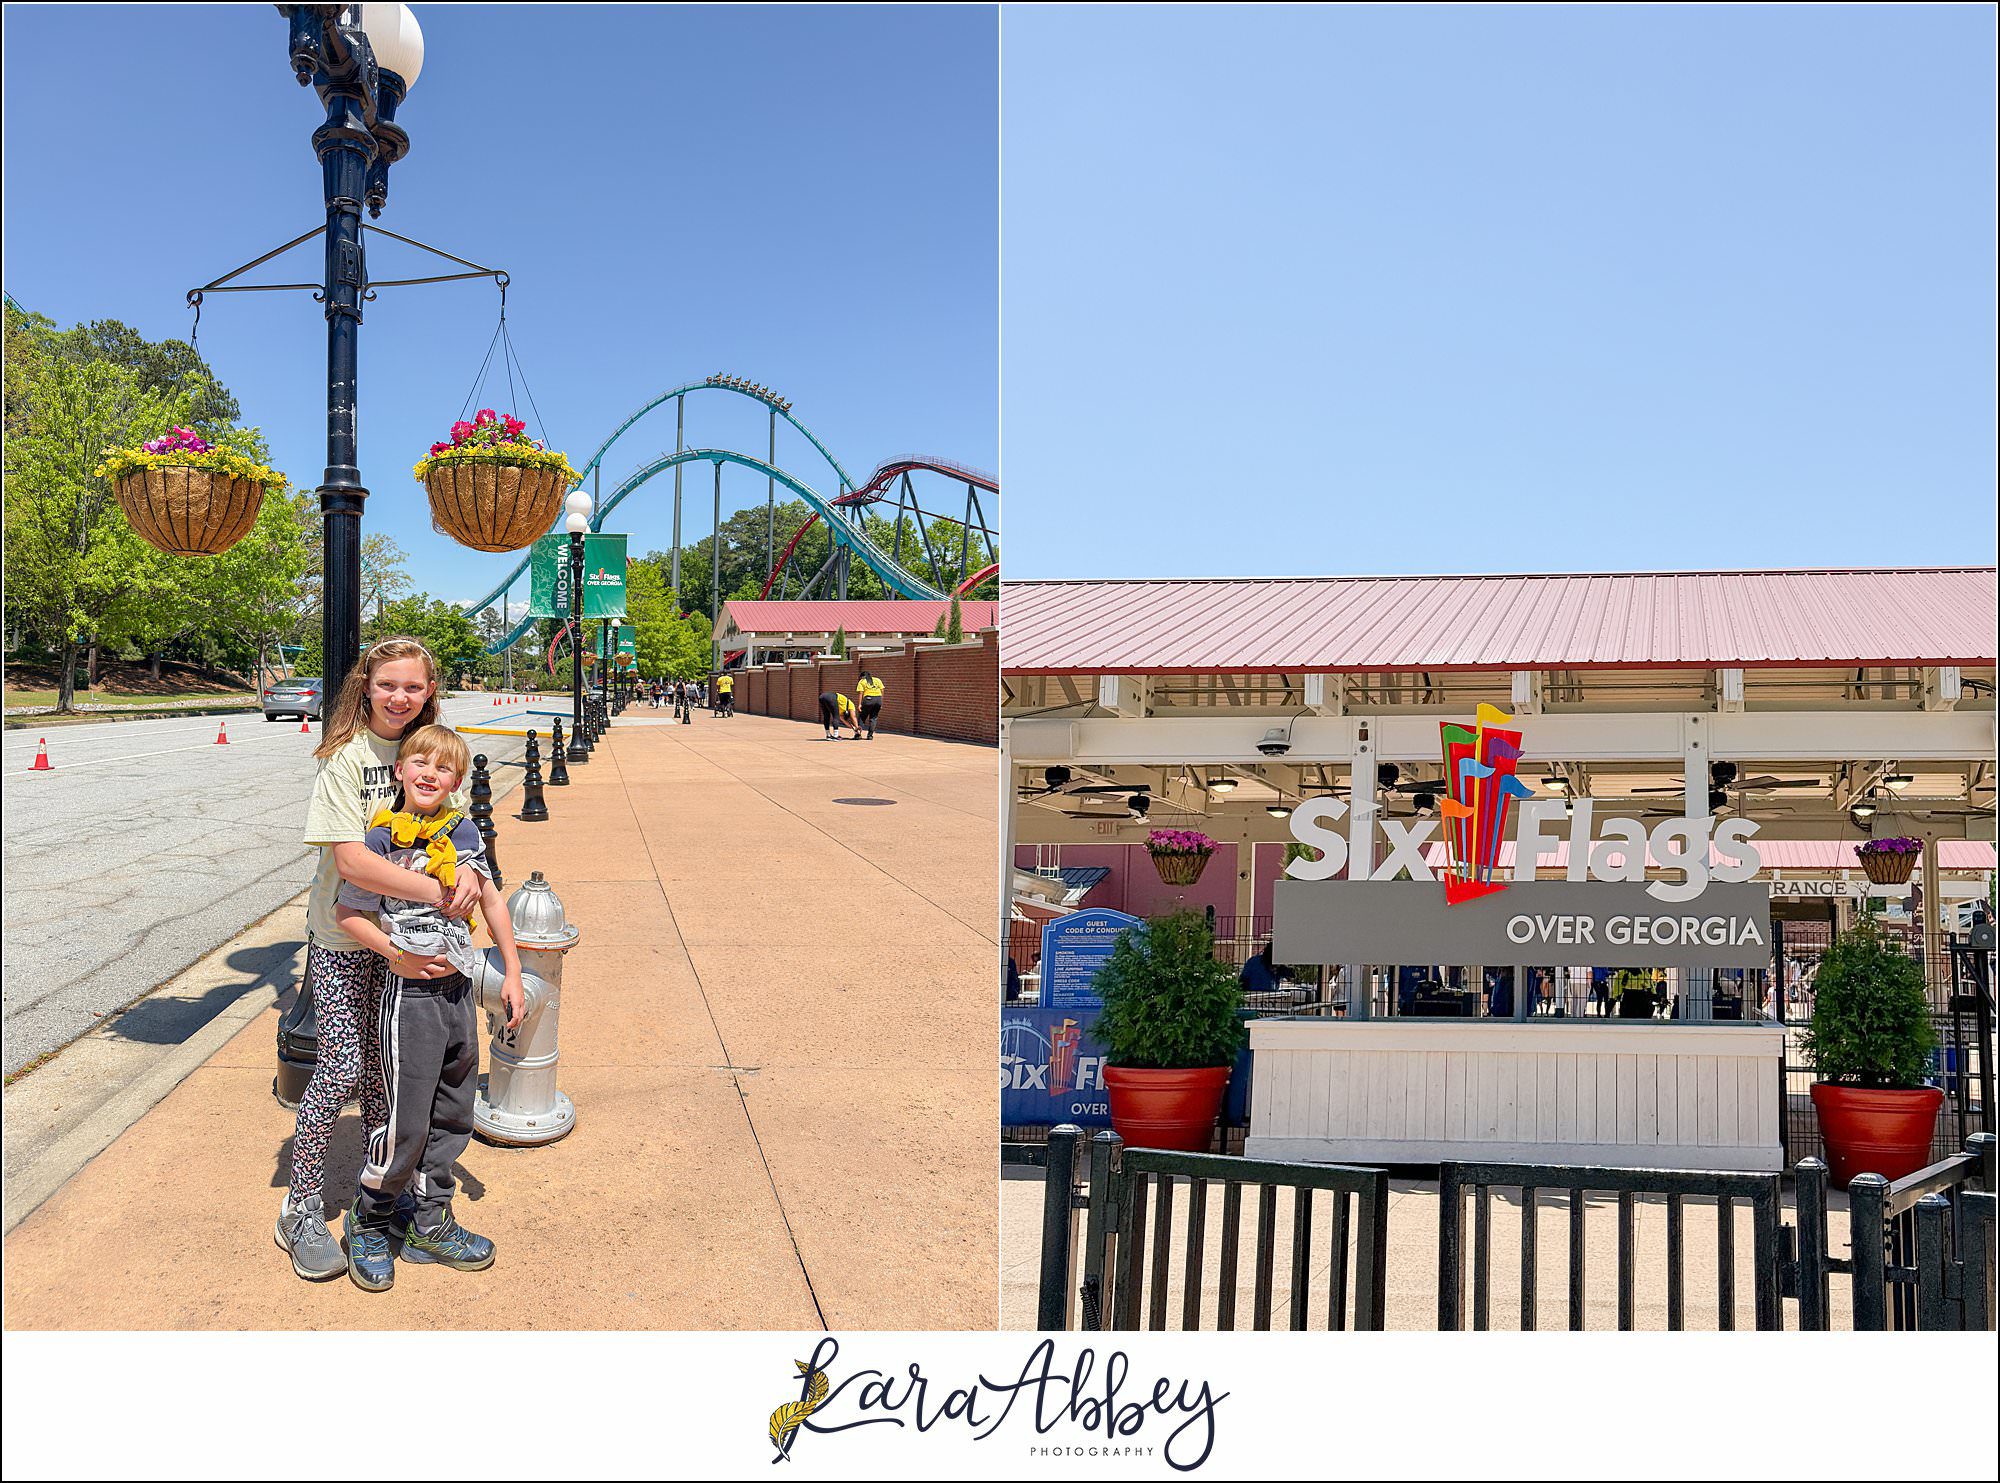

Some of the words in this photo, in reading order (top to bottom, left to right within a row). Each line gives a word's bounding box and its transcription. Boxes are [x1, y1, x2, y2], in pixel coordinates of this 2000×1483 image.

[556, 543, 569, 610] WELCOME
[589, 573, 600, 581] Six
[603, 573, 620, 582] Flags
[1097, 821, 1114, 835] EXIT
[1285, 797, 1439, 881] Six
[1514, 798, 1762, 902] Flags
[1506, 915, 1595, 945] OVER
[1605, 915, 1765, 945] GEORGIA
[498, 1025, 516, 1048] 42
[1071, 1102, 1108, 1115] OVER
